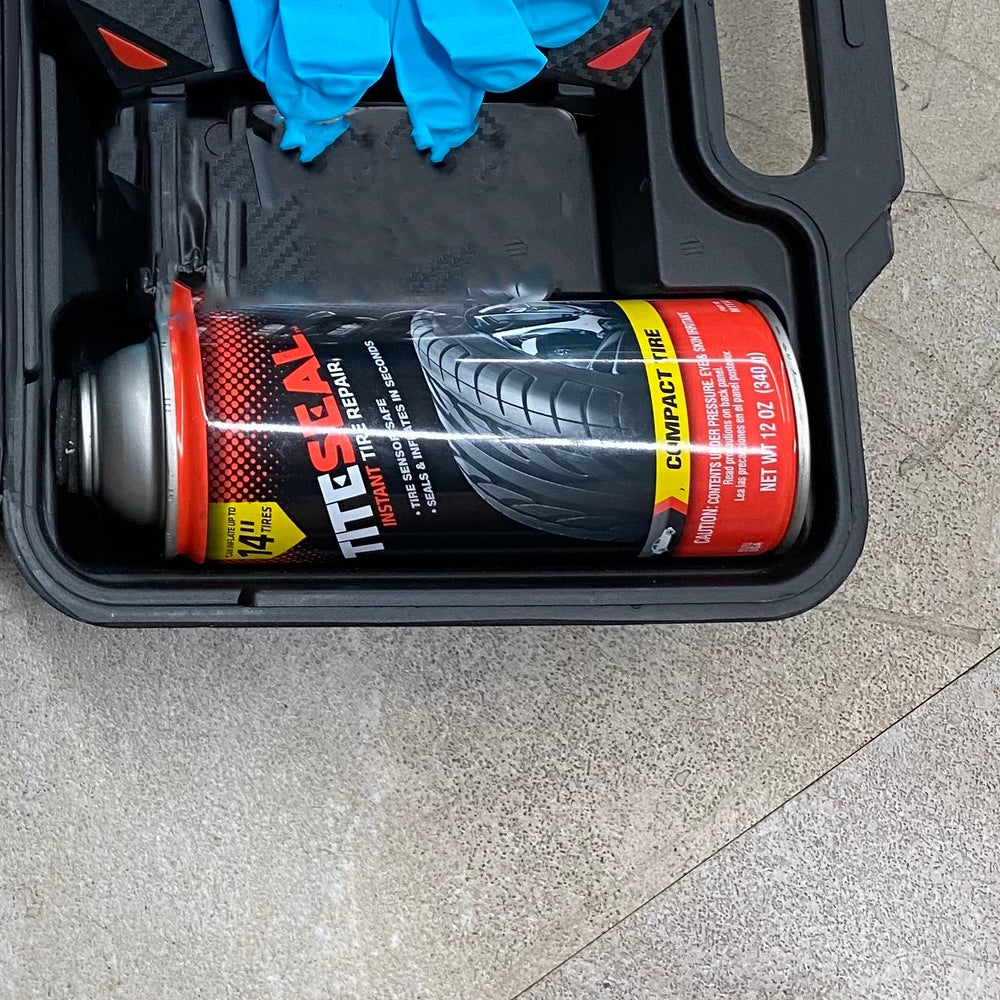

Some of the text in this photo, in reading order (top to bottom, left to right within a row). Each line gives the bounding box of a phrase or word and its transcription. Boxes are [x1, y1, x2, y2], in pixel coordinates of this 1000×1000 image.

[689, 334, 706, 353] SKIN
[750, 366, 775, 394] (340
[644, 329, 682, 470] COMPACT TIRE
[717, 388, 731, 407] back
[756, 401, 775, 419] OZ
[364, 340, 437, 507] SEALS & INFATES IN SECONDS
[375, 398, 396, 430] SAFE
[722, 408, 732, 418] on
[722, 350, 749, 501] Lea las precaciones en el panel posteor.
[351, 422, 376, 462] TIRE
[708, 428, 722, 460] UDER
[722, 420, 736, 464] preautions
[759, 423, 776, 439] 12
[760, 443, 778, 465] WT
[707, 462, 722, 505] CONTENTS
[723, 465, 734, 485] Read
[760, 468, 777, 492] NET
[365, 465, 398, 527] INSTANT
[405, 483, 421, 509] TIRE
[227, 506, 236, 517] TO
[227, 517, 236, 527] UP
[261, 506, 273, 533] TIRES
[694, 505, 719, 544] CAUTION:
[226, 527, 235, 549] INFLATE
